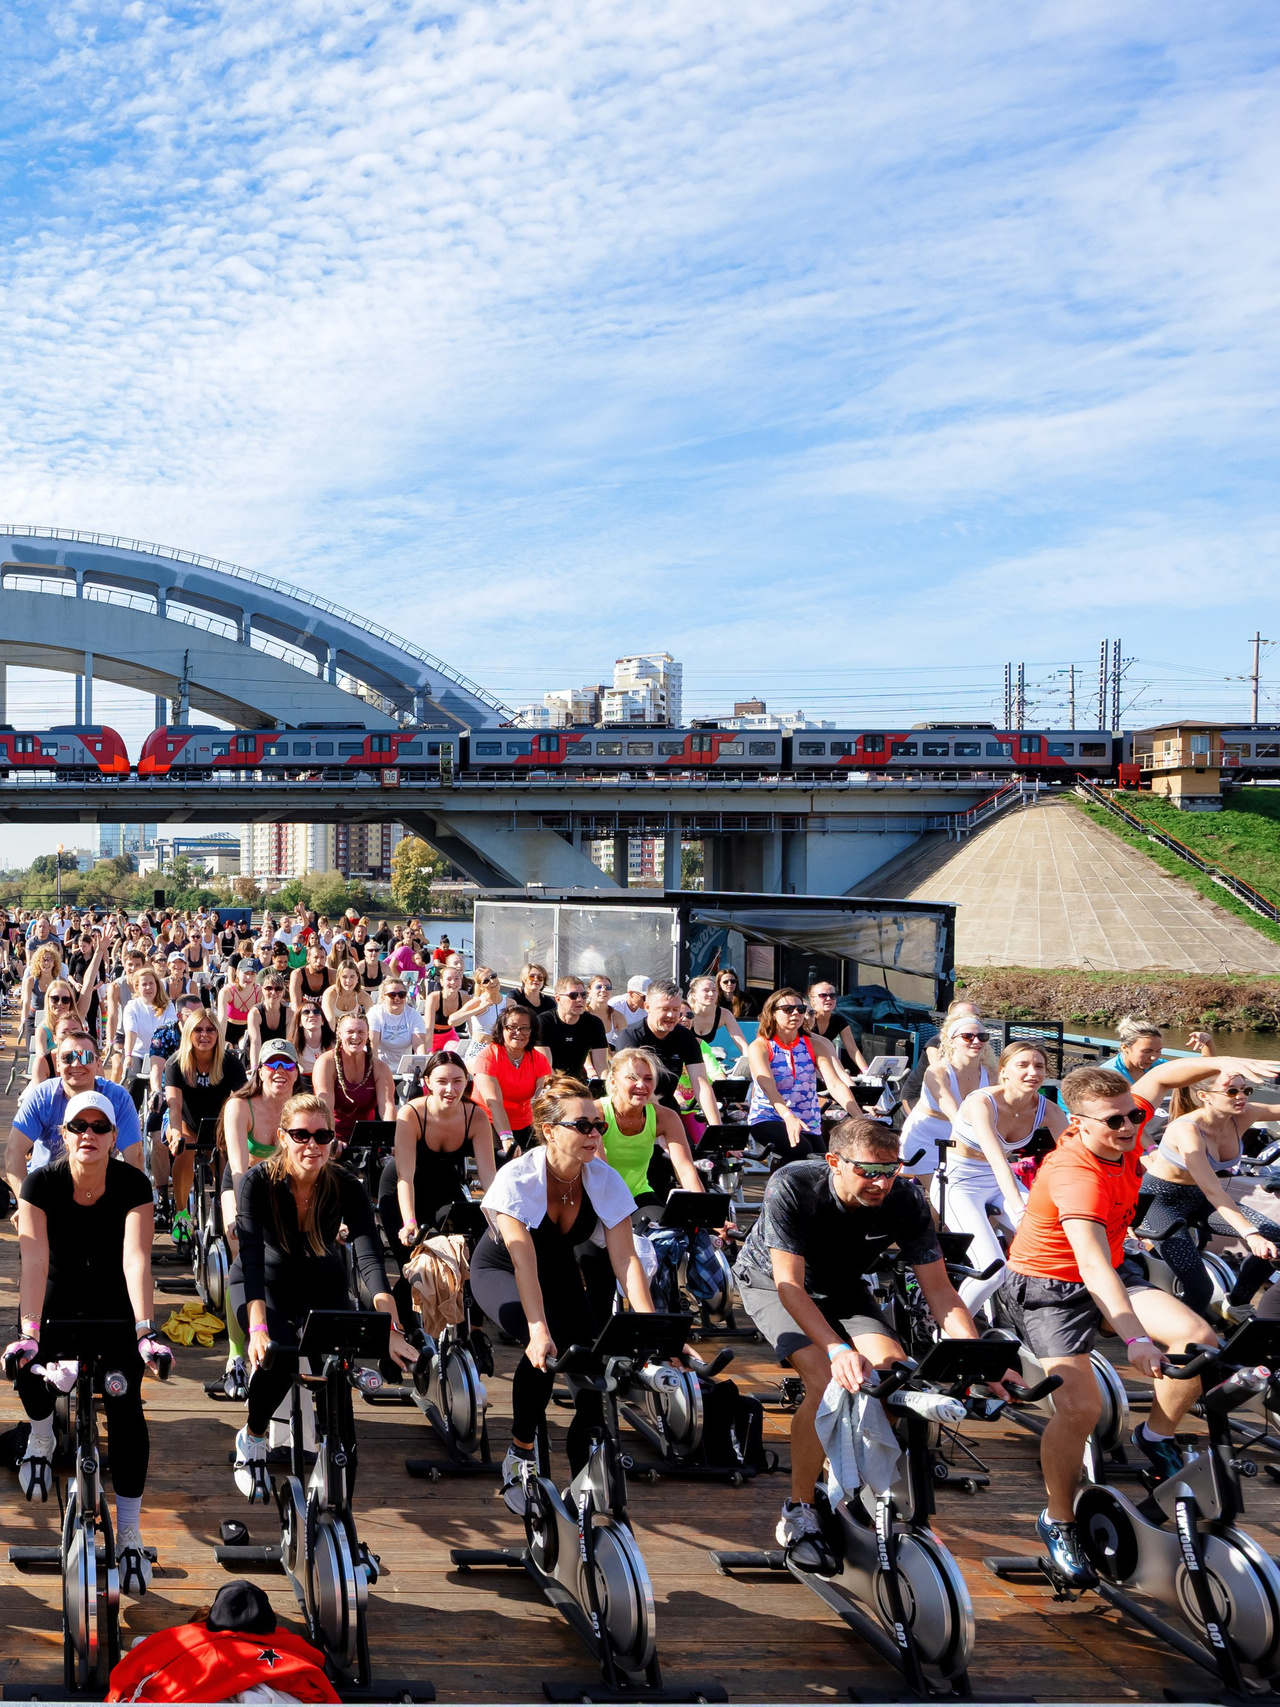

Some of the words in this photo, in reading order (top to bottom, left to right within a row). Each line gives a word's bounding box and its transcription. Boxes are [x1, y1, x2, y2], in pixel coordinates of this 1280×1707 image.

[384, 772, 396, 781] 136
[875, 1501, 891, 1570] GYMTOUCH
[1176, 1501, 1200, 1571] GYMTOUCH
[591, 1612, 601, 1639] 007
[895, 1622, 908, 1648] 007
[1207, 1622, 1226, 1649] 007
